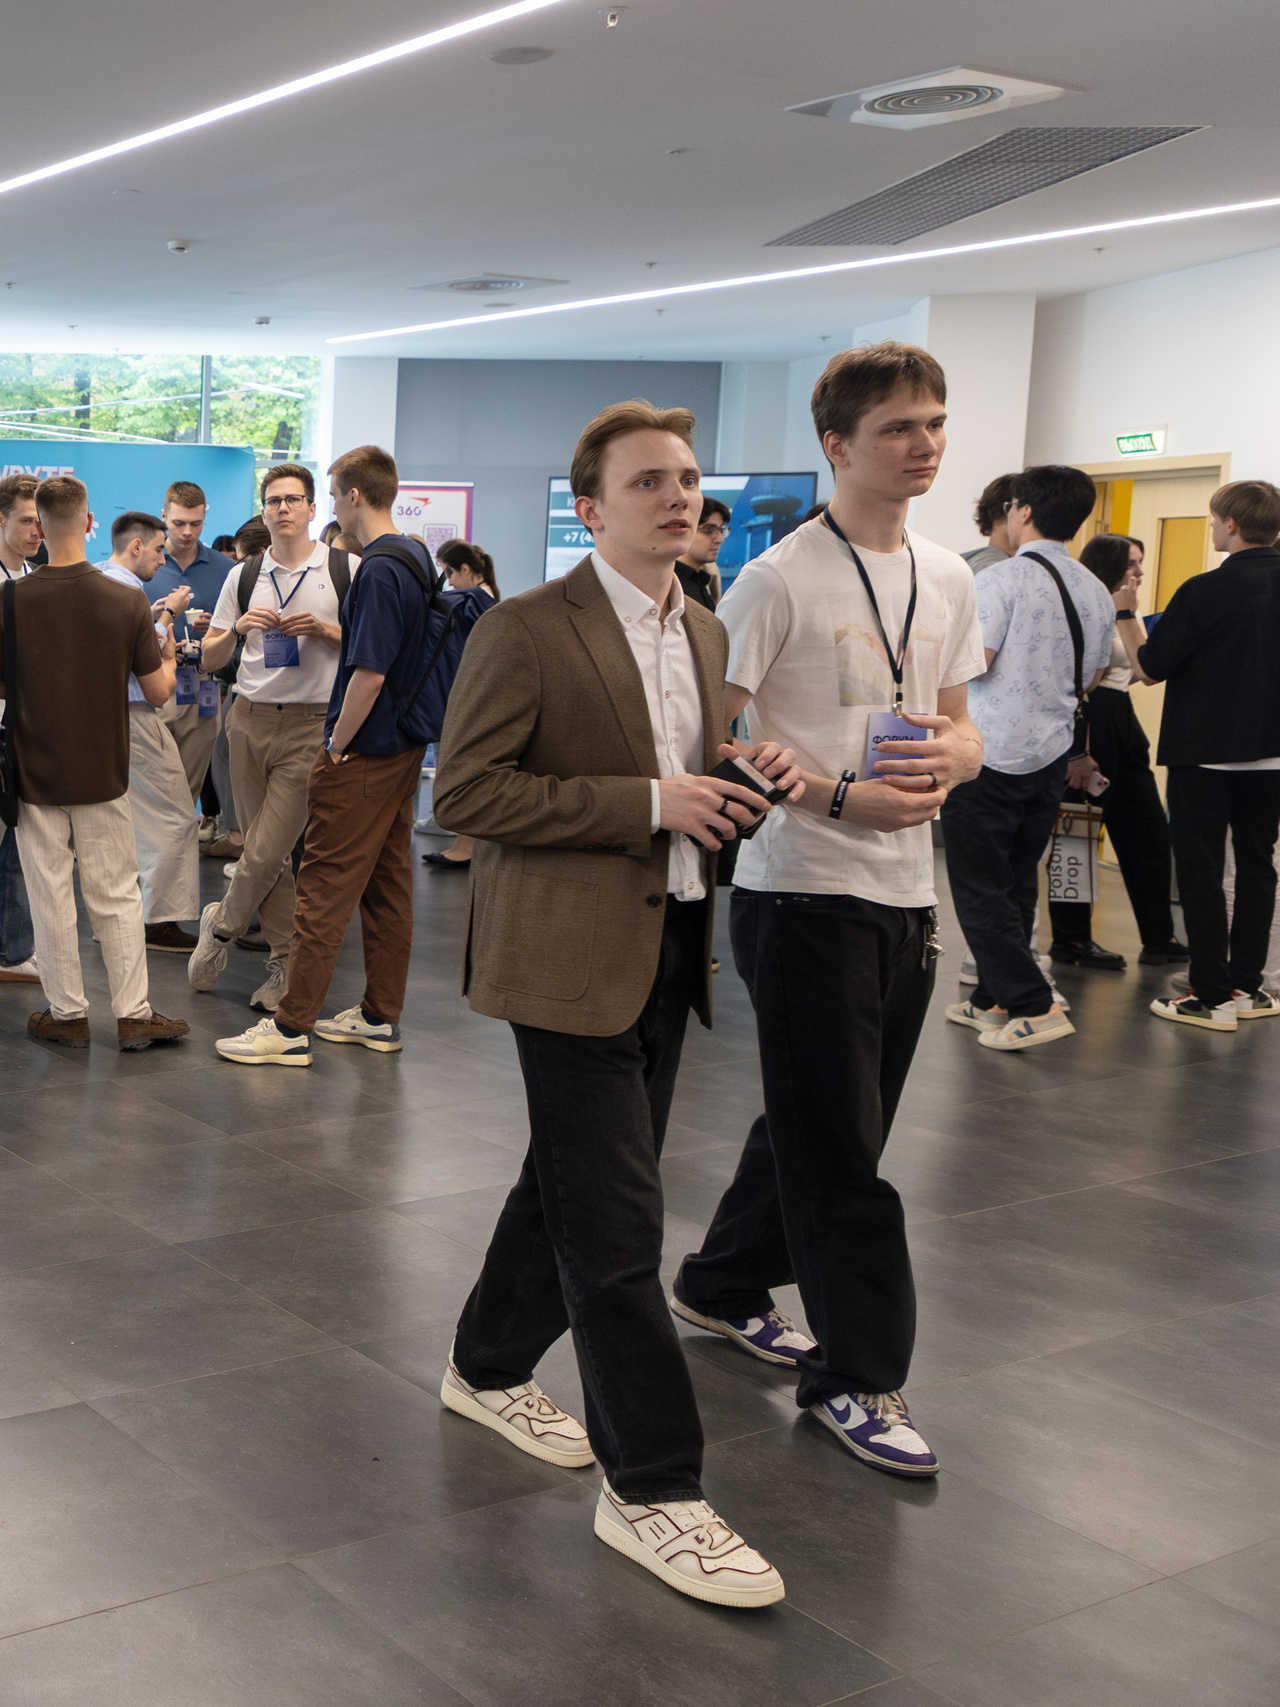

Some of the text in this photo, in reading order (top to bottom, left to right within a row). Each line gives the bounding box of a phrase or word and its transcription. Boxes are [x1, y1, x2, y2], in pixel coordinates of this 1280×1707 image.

[397, 506, 422, 516] 360
[563, 531, 579, 543] +7
[1064, 857, 1083, 898] Drop
